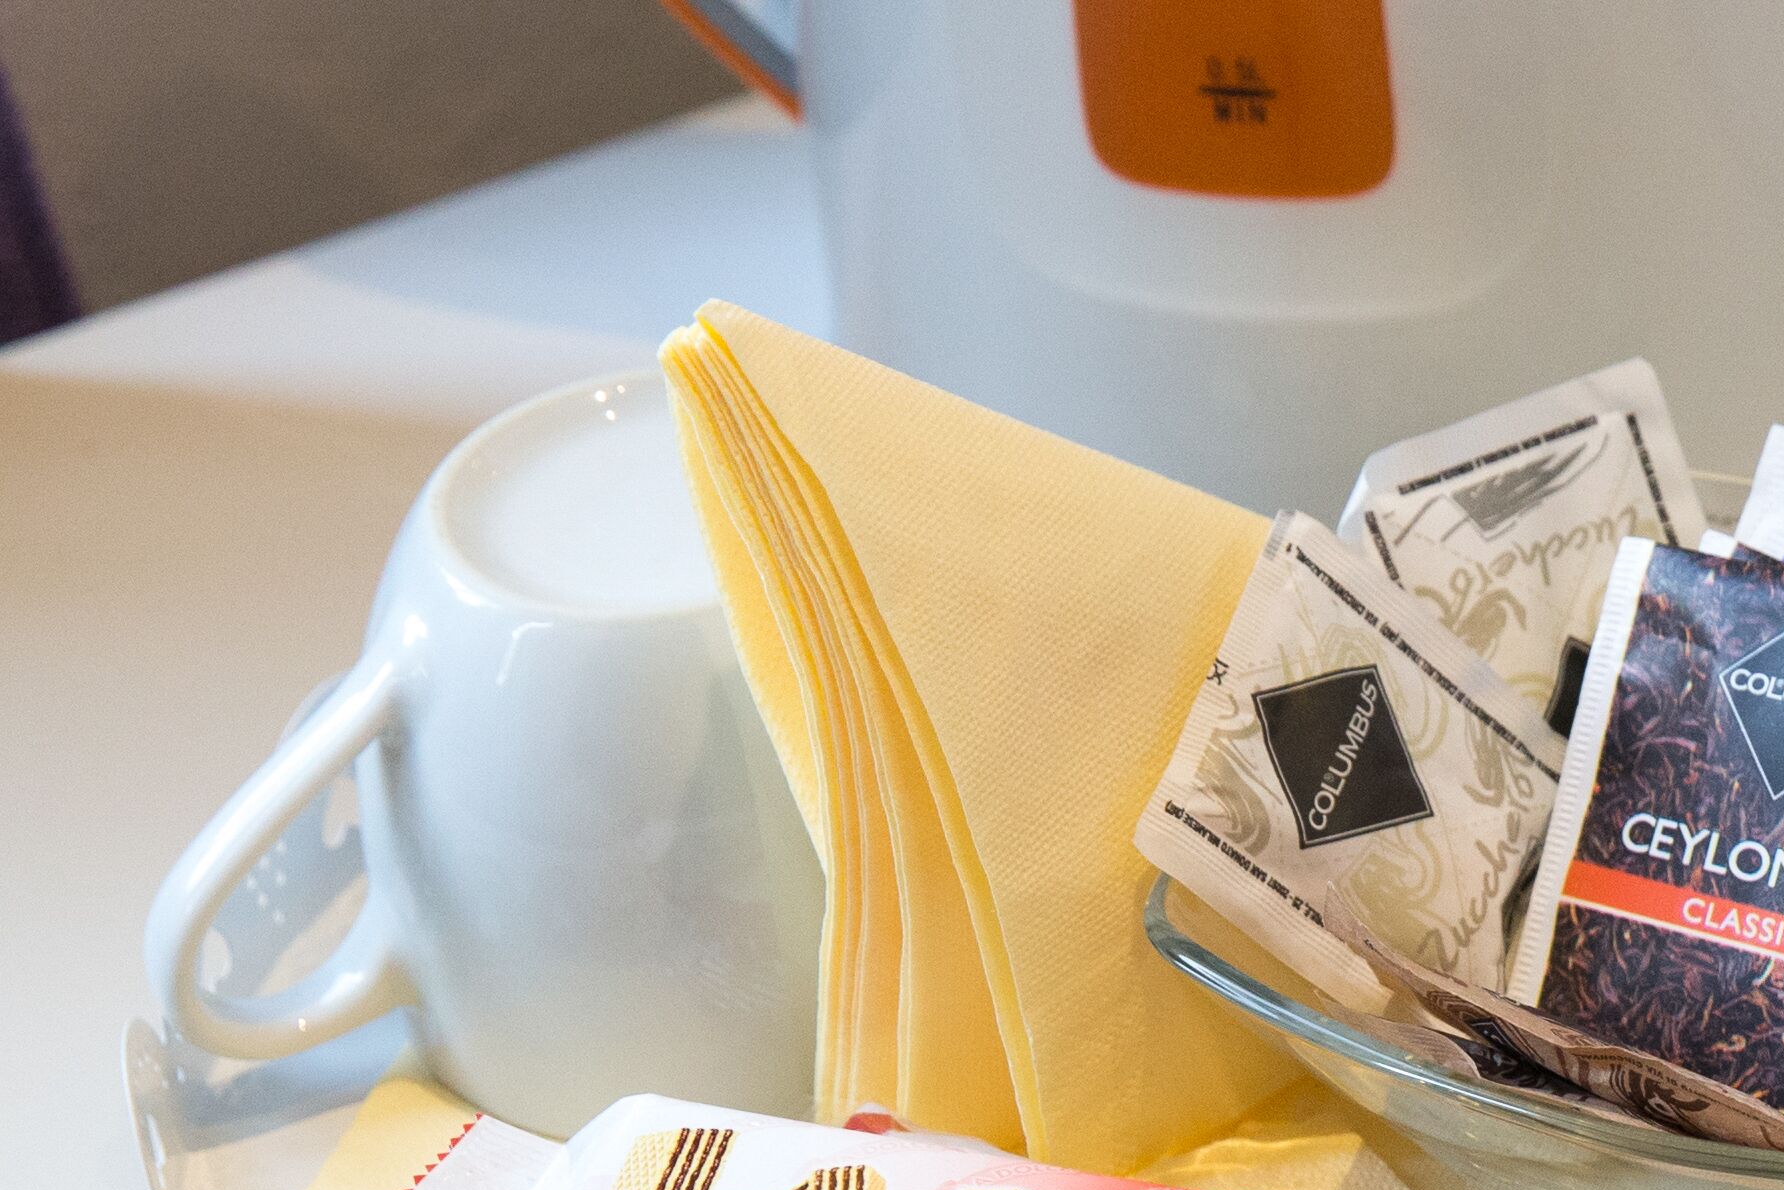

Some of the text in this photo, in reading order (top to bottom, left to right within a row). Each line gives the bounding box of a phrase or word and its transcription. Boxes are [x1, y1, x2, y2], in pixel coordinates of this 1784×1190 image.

[1309, 678, 1379, 832] COLUMBUS
[1183, 813, 1222, 848] MILANESE
[1220, 841, 1252, 872] DONATO
